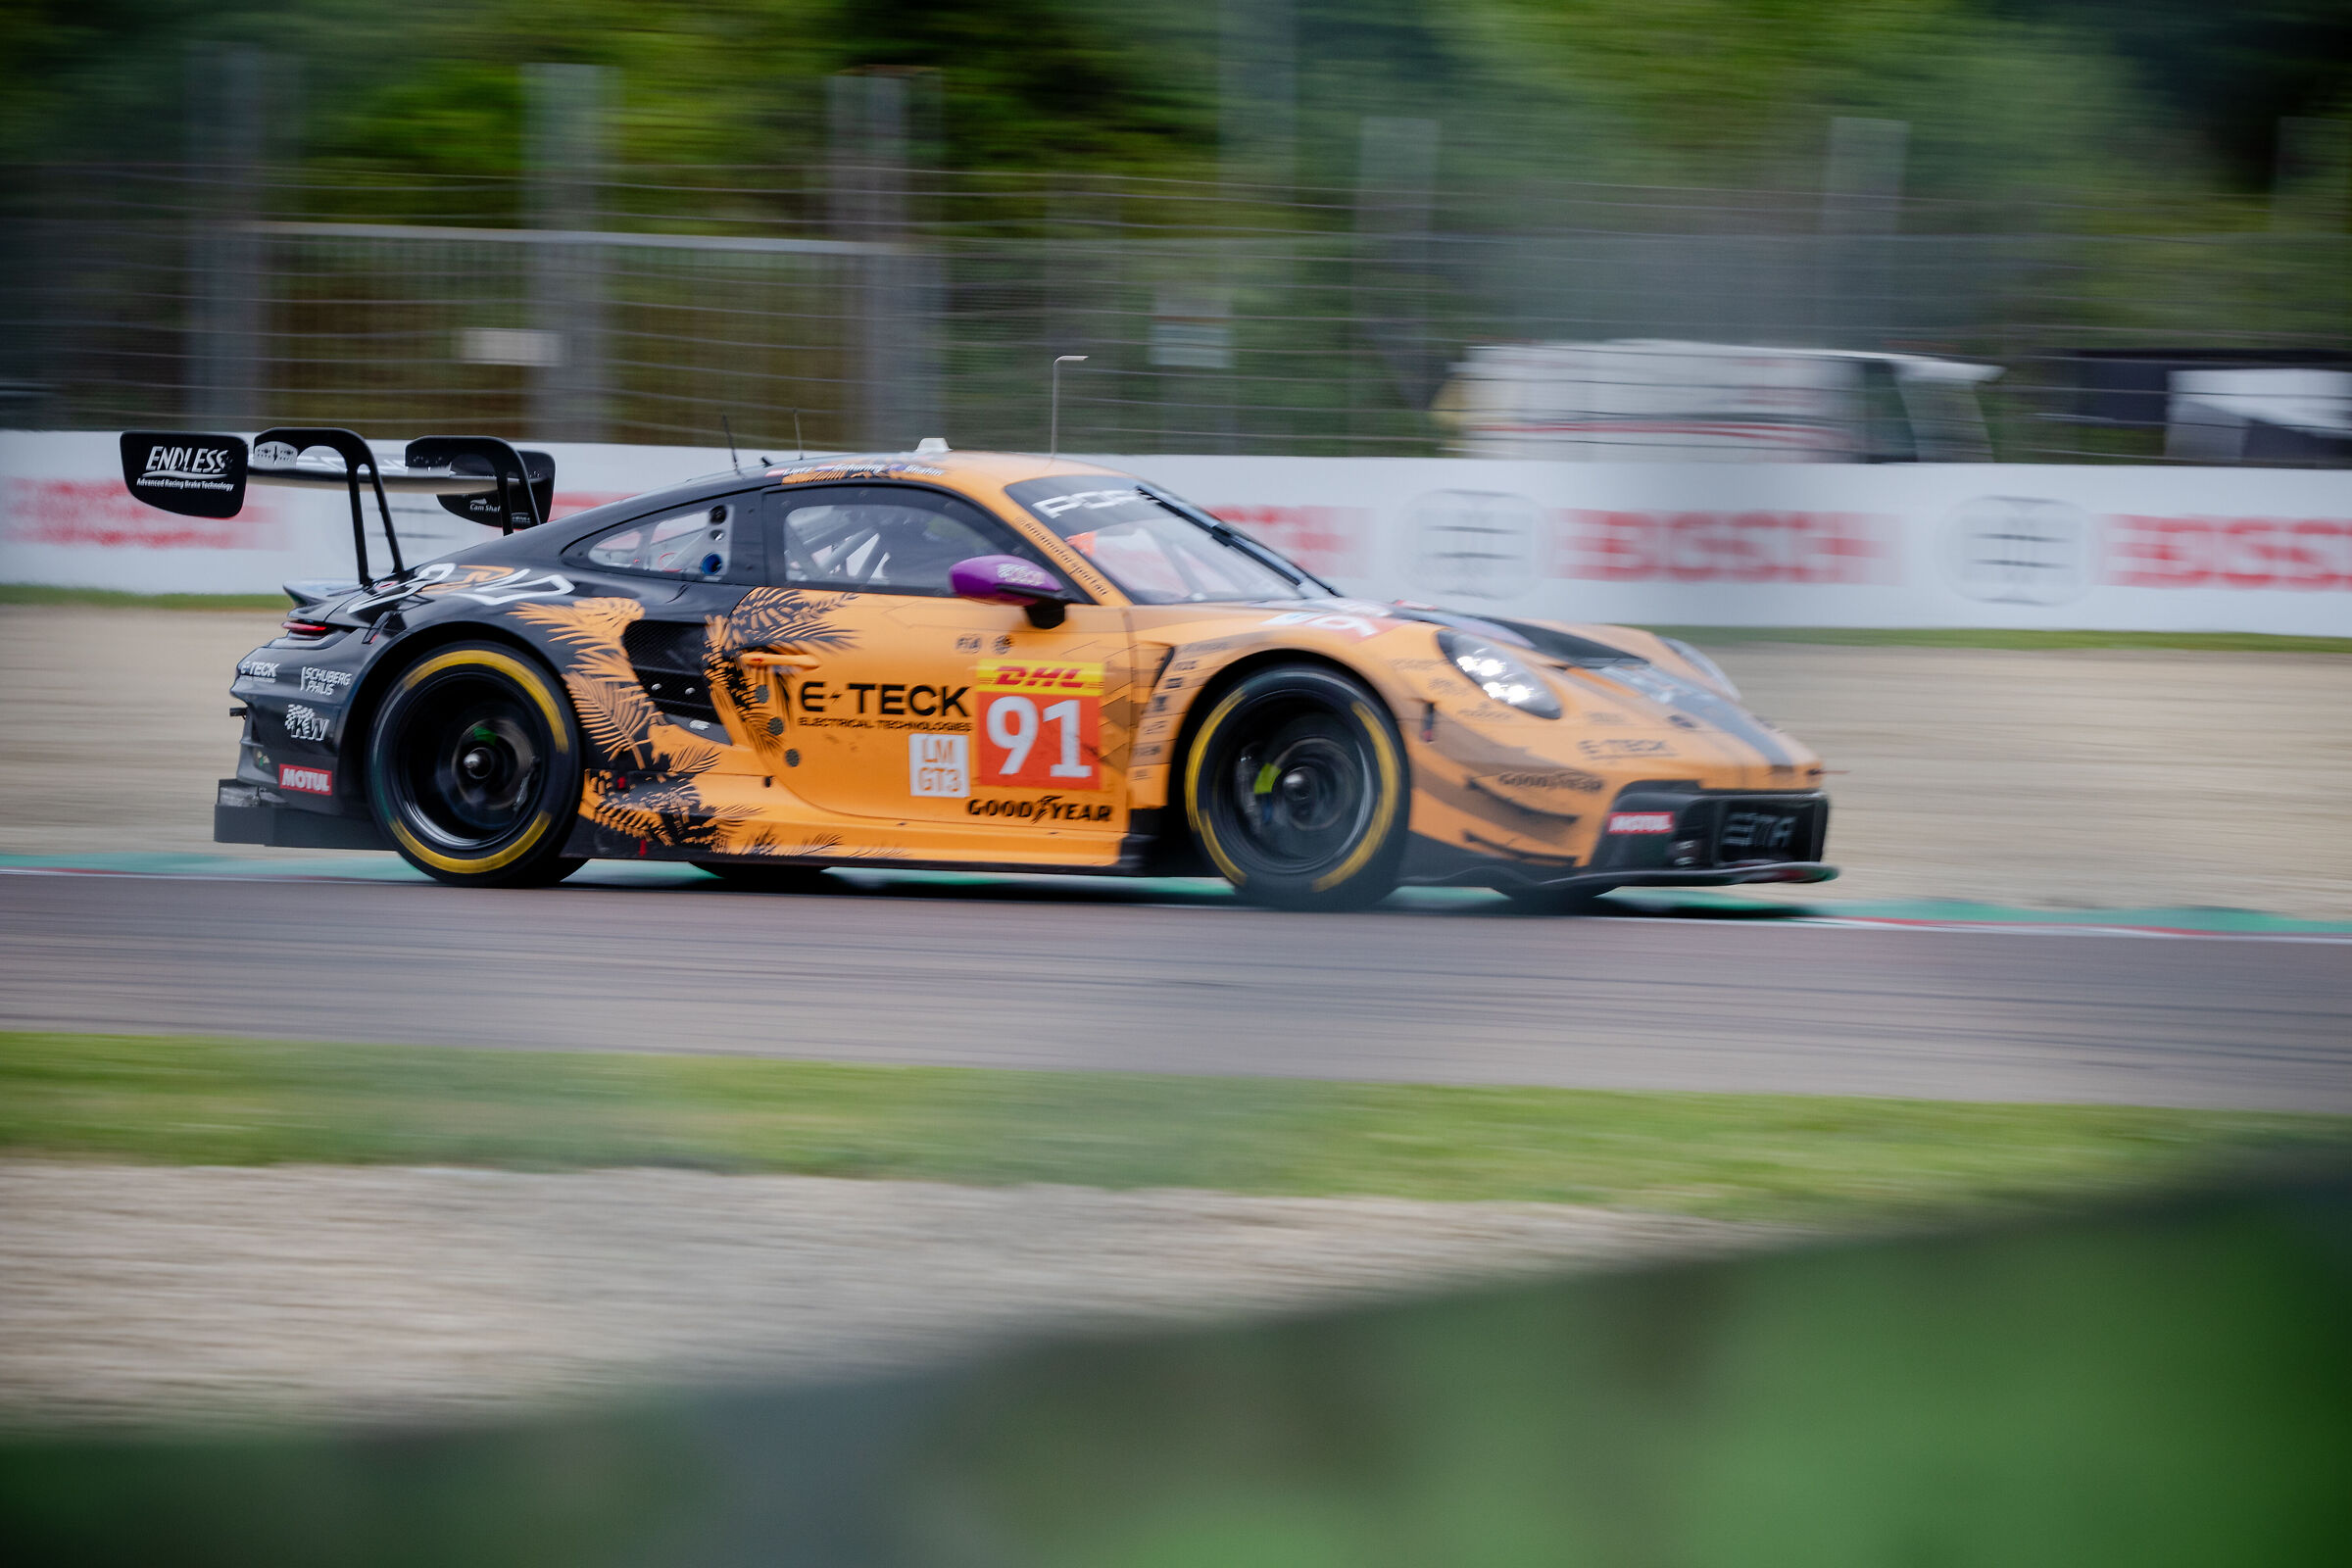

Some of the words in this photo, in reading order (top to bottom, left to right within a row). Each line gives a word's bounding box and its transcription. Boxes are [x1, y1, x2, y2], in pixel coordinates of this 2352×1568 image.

[145, 446, 231, 473] ENDLESS
[137, 478, 164, 488] Advanced
[165, 479, 184, 490] Racing
[185, 480, 201, 489] Brake
[201, 480, 234, 492] Technology
[470, 504, 484, 513] Cam
[485, 504, 501, 514] Shaf
[305, 666, 354, 686] SCHUBERG
[994, 666, 1084, 688] DHL
[801, 681, 971, 717] E-TECK
[799, 716, 874, 729] ELECTRICAL
[877, 719, 973, 732] TECHNOLOGIES
[986, 695, 1093, 779] 91
[921, 739, 955, 763] LM
[282, 768, 330, 792] MOTUL
[917, 767, 960, 793] GT3
[965, 795, 1114, 824] GOODYEAR
